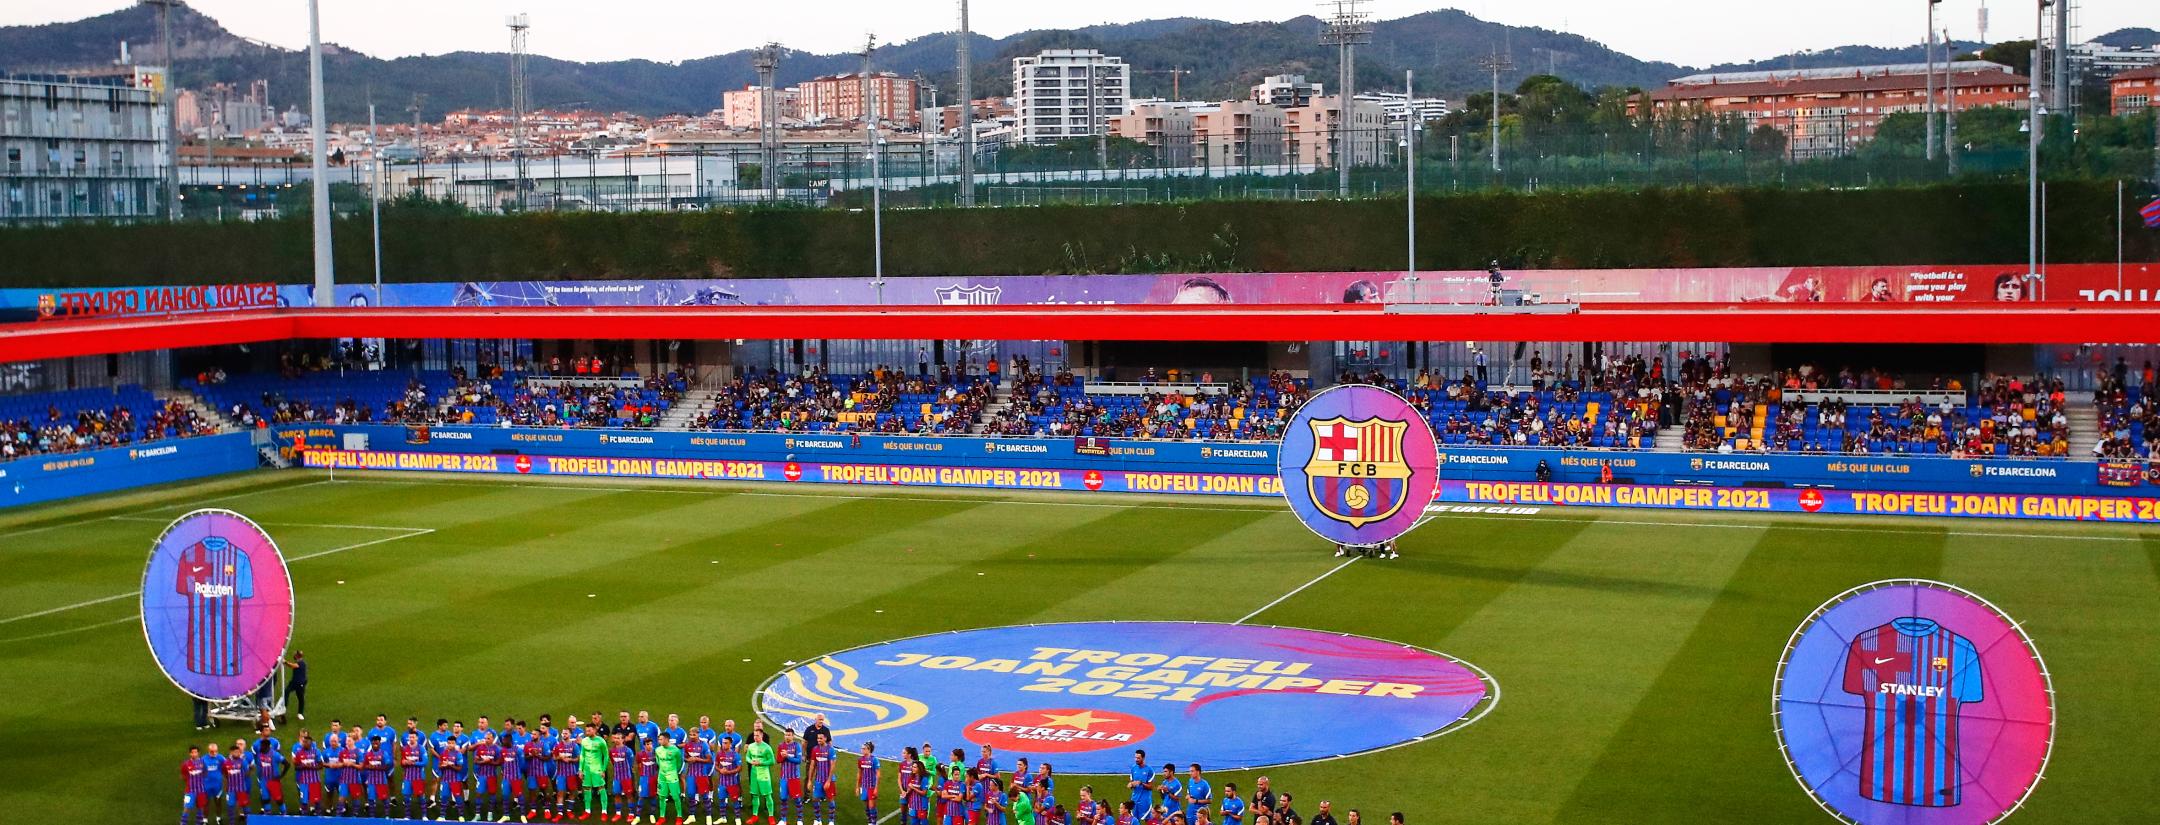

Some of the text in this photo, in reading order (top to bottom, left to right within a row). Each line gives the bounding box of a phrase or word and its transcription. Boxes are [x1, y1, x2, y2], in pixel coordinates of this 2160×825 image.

[1930, 284, 1946, 292] you
[1947, 283, 1967, 292] play
[1915, 293, 1934, 301] with
[438, 432, 472, 440] BARCELONA
[618, 436, 654, 444] BARCELONA
[691, 436, 705, 445] MÉS
[705, 438, 718, 446] QUE
[729, 438, 746, 446] CLUB
[796, 440, 843, 449] FC BARCELONA
[883, 441, 898, 450] MÉS
[924, 443, 943, 451] CLUB
[997, 444, 1047, 453] FC BARCELONA
[1109, 447, 1123, 456] QUE
[1136, 448, 1155, 456] CLUB
[1223, 450, 1268, 459] BARCELONA
[304, 450, 358, 466] TROFEU
[359, 452, 396, 467] JOAN
[399, 453, 461, 469] GAMPER
[463, 455, 498, 471] 2021
[1449, 455, 1509, 465] FC BARCELONA
[1560, 456, 1579, 466] MÉS
[1580, 458, 1598, 467] QUE
[1613, 458, 1636, 467] CLUB
[1706, 460, 1770, 471] FC BARCELONA
[548, 457, 608, 474] TROFEU
[609, 459, 652, 475] JOAN
[655, 460, 724, 477] GAMPER
[727, 462, 765, 479] 2021
[1827, 461, 1910, 473] MÉS QUE UN CLUB
[1986, 466, 2056, 477] FC BARCELONA
[820, 465, 1062, 487] TROFEU JOAN GAMPER 2021
[1125, 473, 1199, 491] TROFEU
[1202, 475, 1254, 493] JOAN
[1466, 482, 1770, 508] TROFEU JOAN GAMPER 2021
[1451, 505, 1485, 513] UN
[1485, 506, 1540, 515] CLUB
[1852, 492, 1946, 513] TROFEU
[1950, 495, 2017, 515] JOAN
[2022, 497, 2133, 519] GAMPER
[194, 581, 234, 596] Rakuten
[1029, 647, 1313, 676] TROFEU
[874, 653, 1425, 699] JOAN GAMPER
[1018, 677, 1205, 702] 2021
[1880, 682, 1945, 698] STANLEY
[974, 723, 1132, 743] ESTRELLA
[1016, 733, 1075, 742] DAMM
